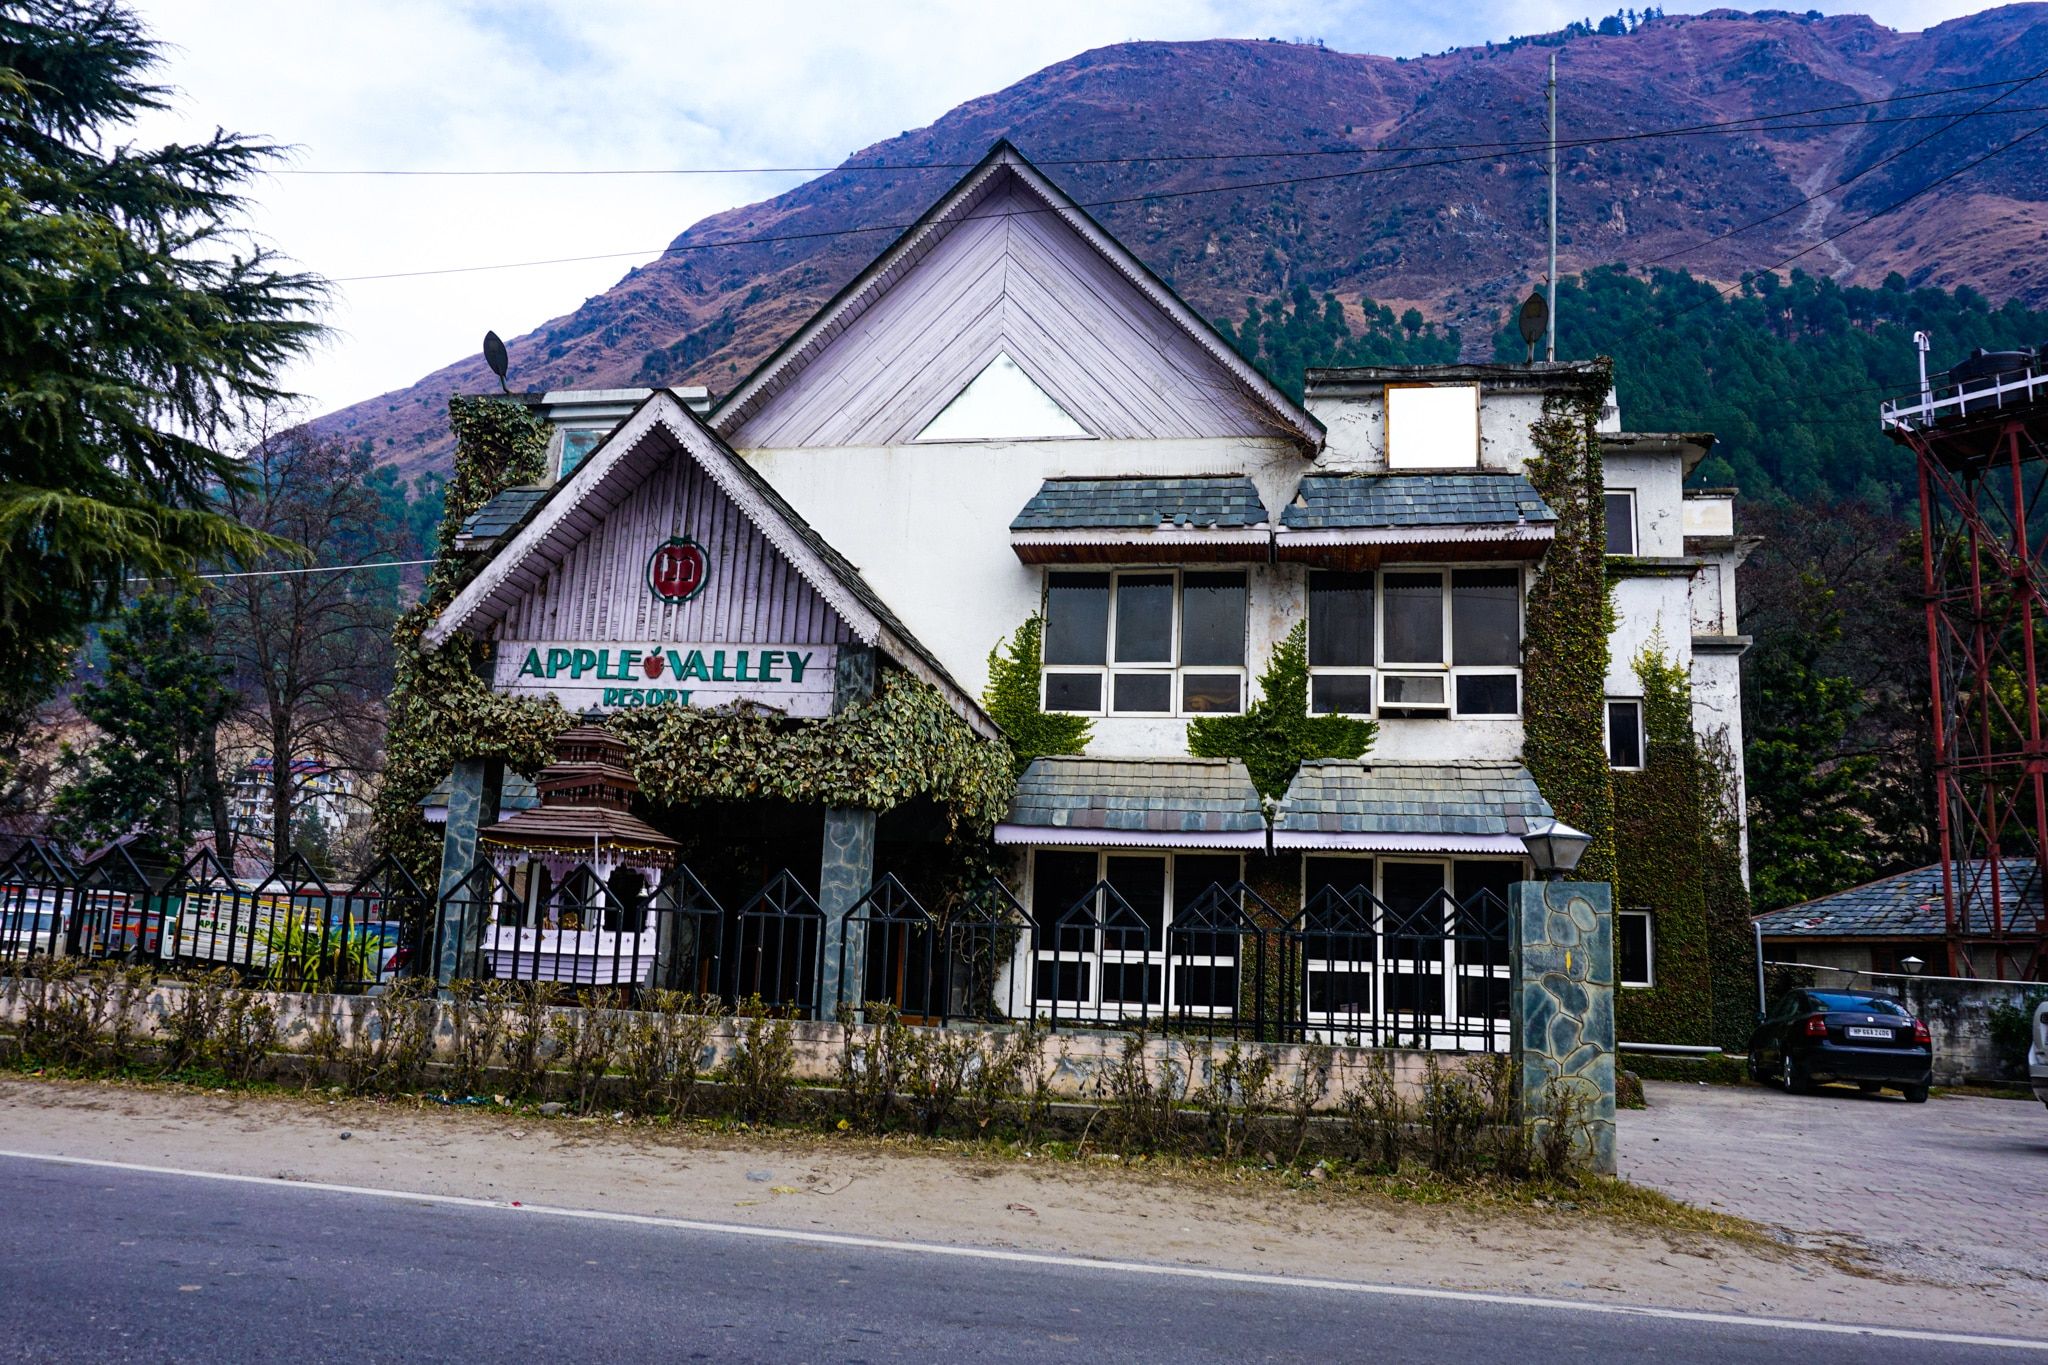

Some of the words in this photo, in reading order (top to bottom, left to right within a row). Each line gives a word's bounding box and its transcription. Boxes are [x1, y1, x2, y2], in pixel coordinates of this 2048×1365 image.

[518, 647, 642, 681] APPLE
[666, 649, 813, 682] VALLEY
[603, 687, 693, 708] RESORT
